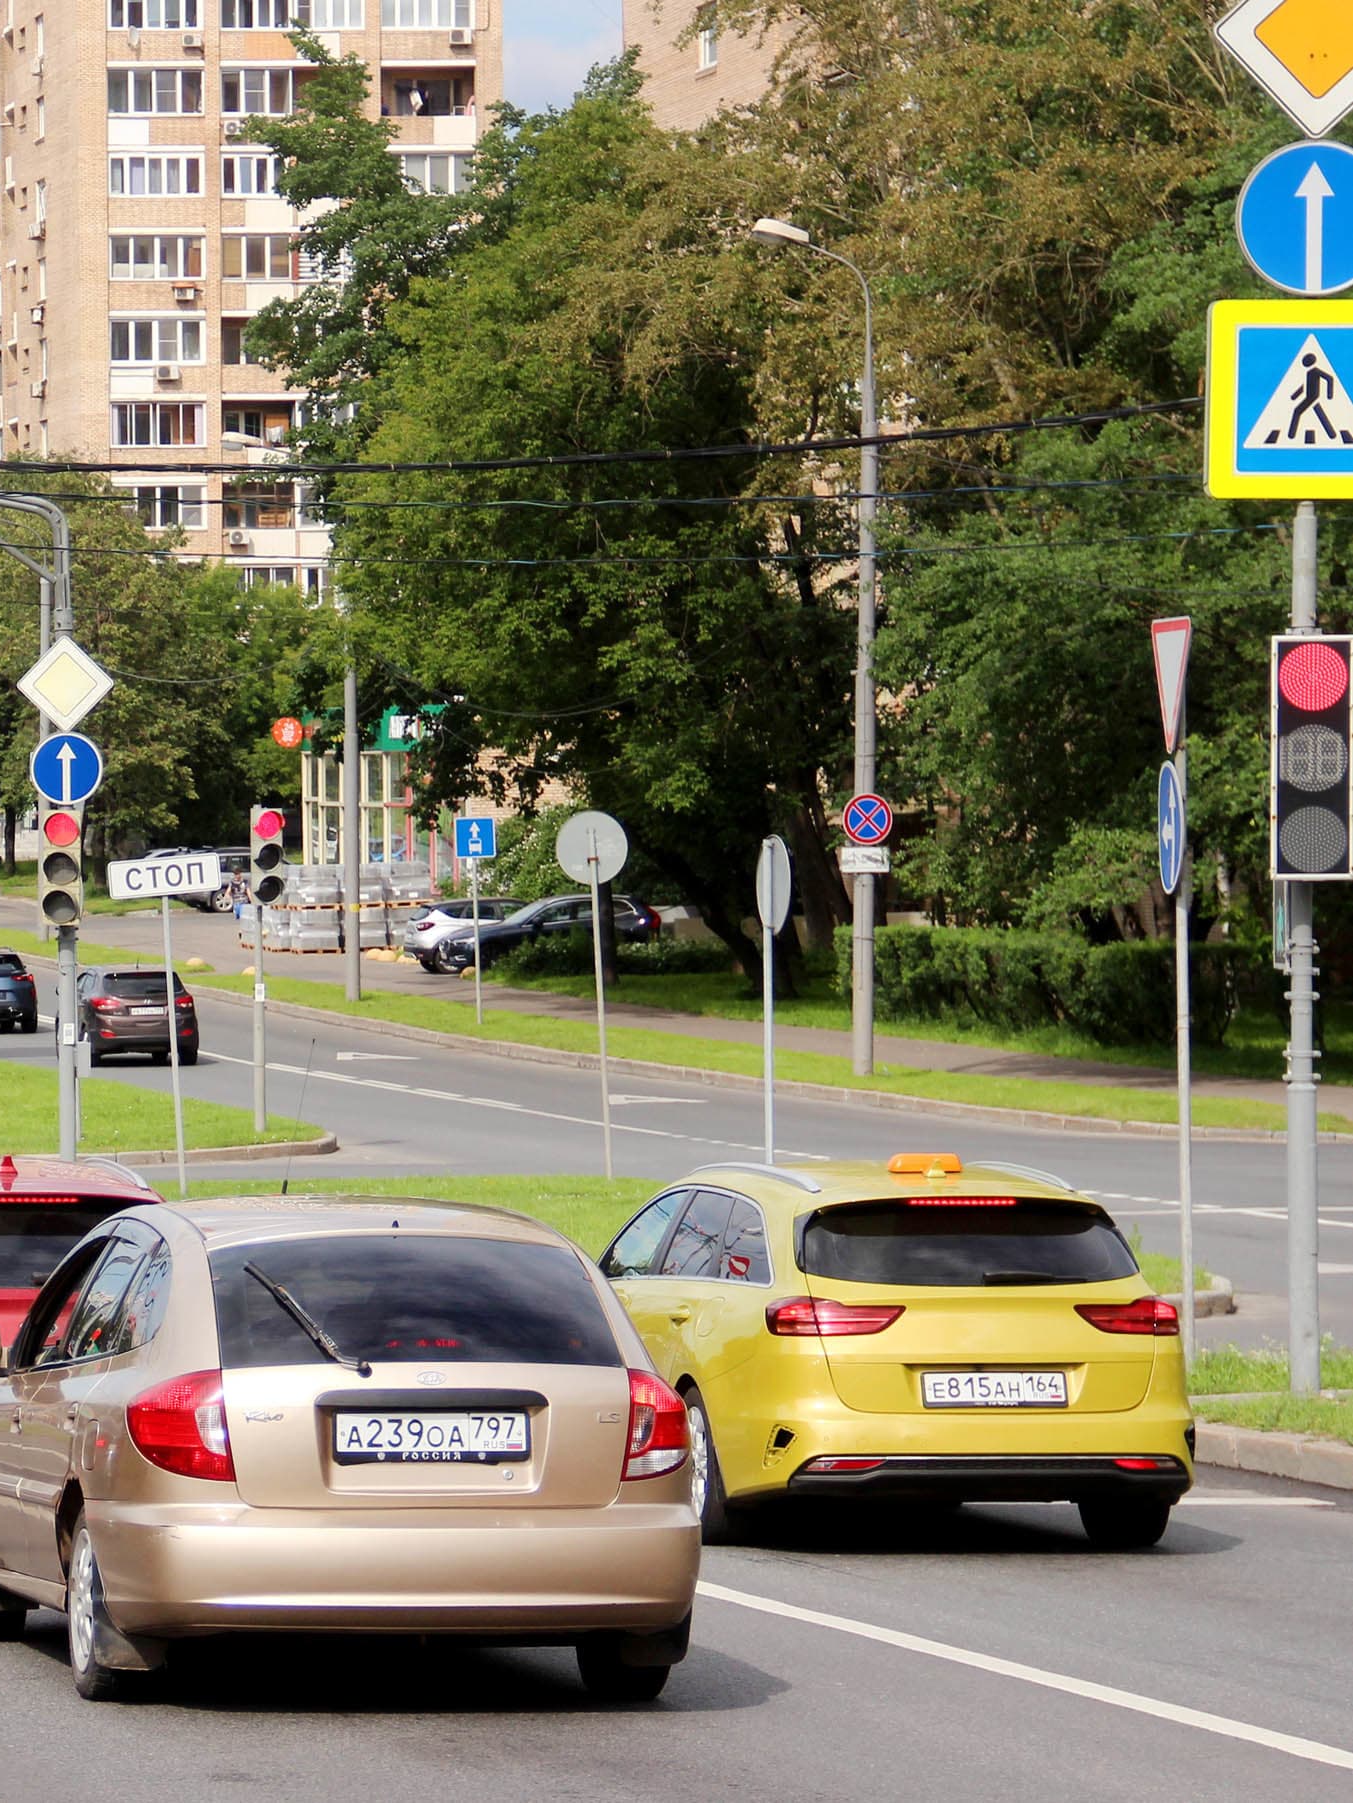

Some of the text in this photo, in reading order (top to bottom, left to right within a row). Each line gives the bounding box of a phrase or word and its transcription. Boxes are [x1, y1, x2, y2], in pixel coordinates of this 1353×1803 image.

[126, 862, 204, 891] СТОП
[1025, 1375, 1059, 1393] 164
[471, 1416, 516, 1439] 797
[483, 1440, 506, 1449] RUS
[402, 1451, 461, 1460] РОССИЯ
